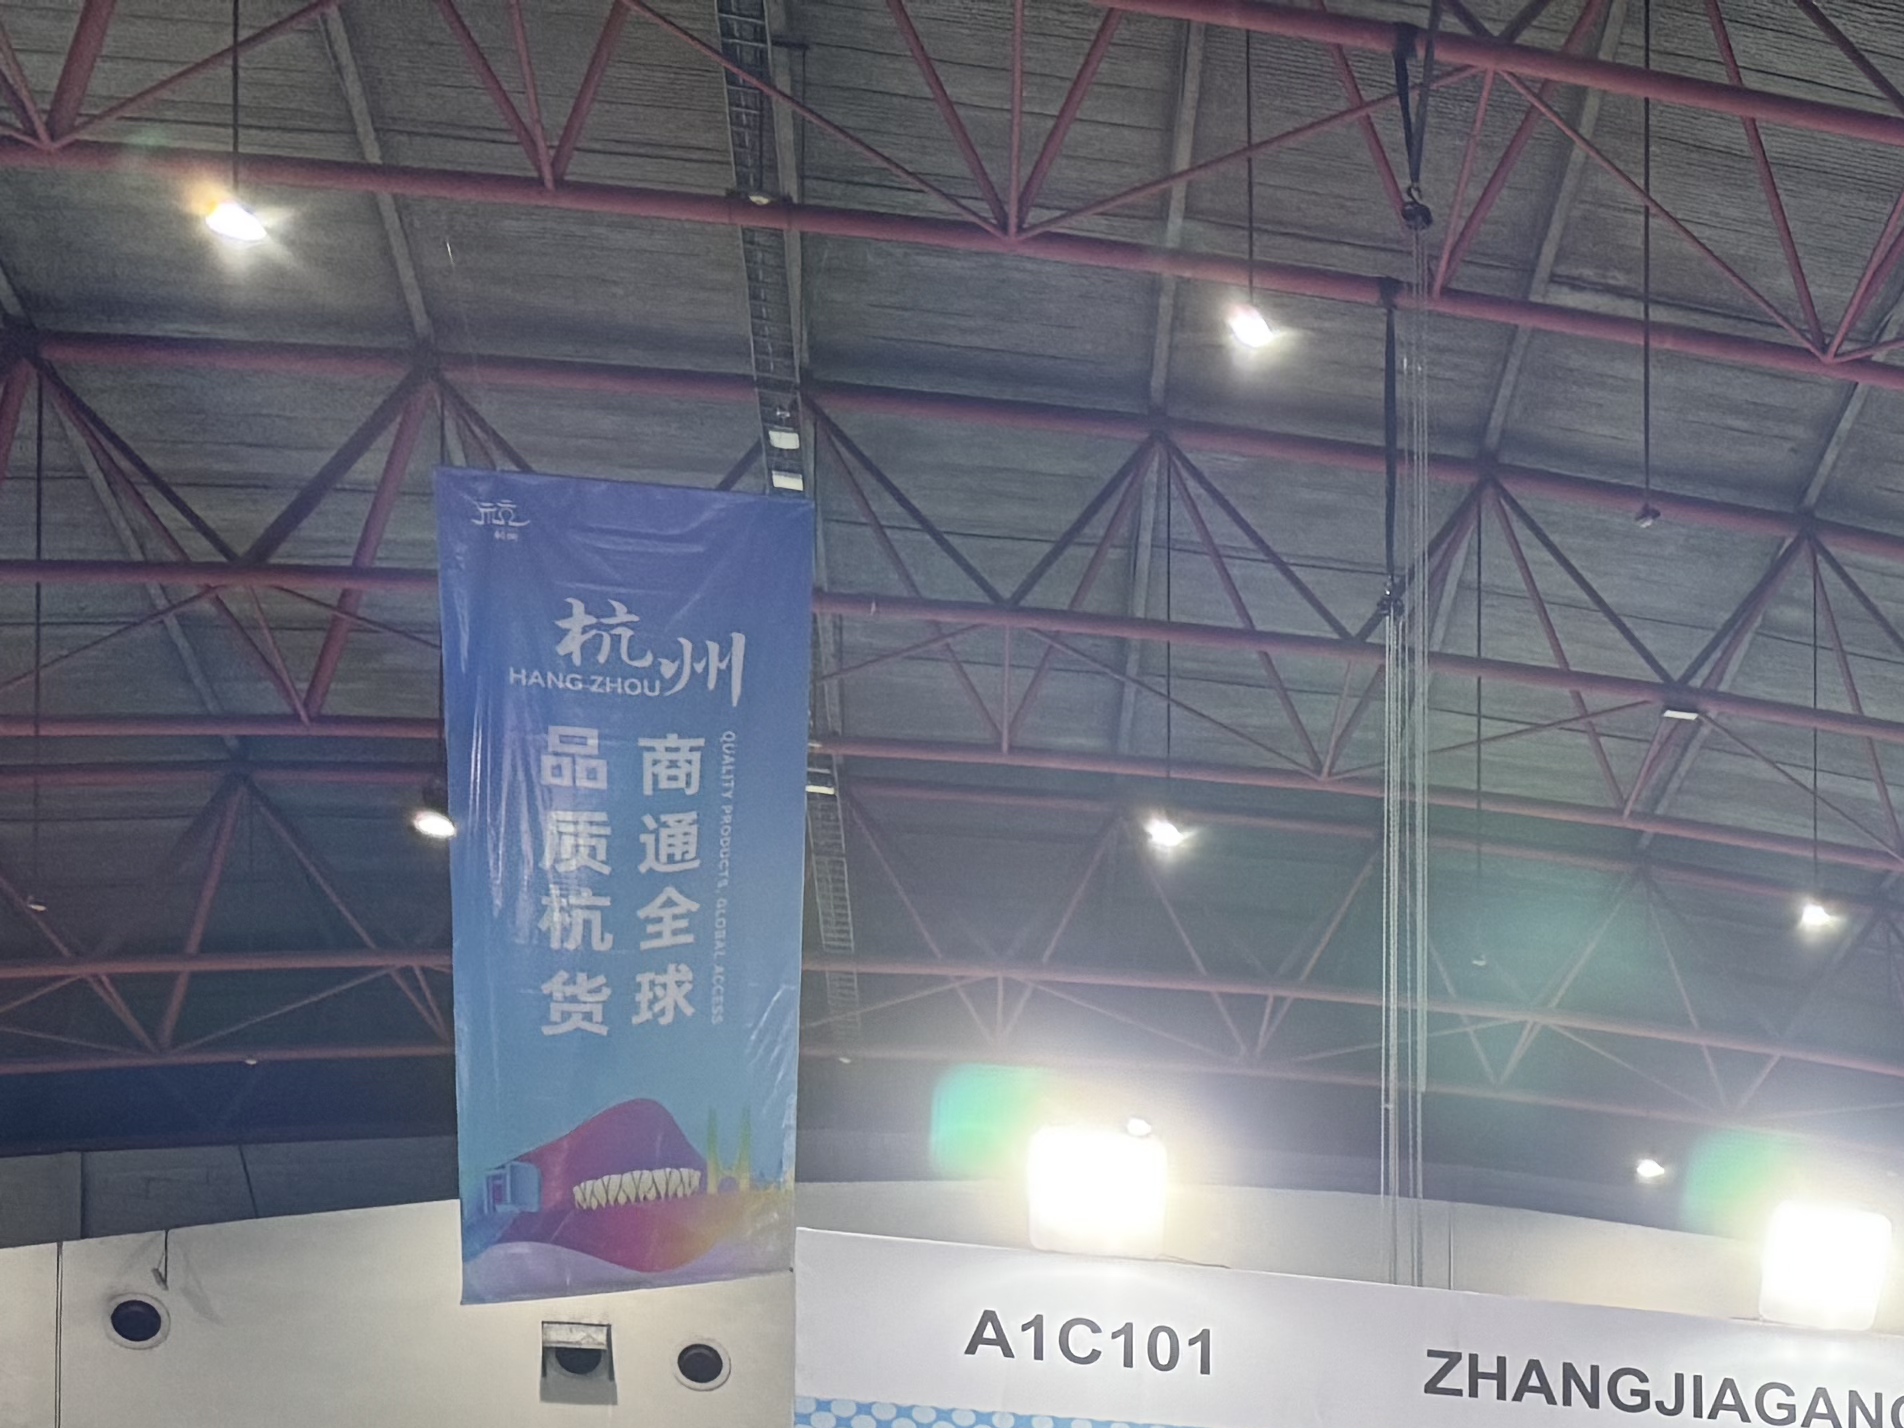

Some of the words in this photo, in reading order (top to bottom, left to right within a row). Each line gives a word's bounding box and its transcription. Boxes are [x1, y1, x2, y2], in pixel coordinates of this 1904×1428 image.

[509, 667, 583, 691] HANG
[590, 676, 661, 697] ZHOU
[554, 597, 745, 707] 杭州
[719, 730, 736, 800] QUALITY
[538, 725, 613, 1036] 品质杭货
[632, 733, 705, 1025] 商通全球
[964, 1309, 1213, 1377] A1C101
